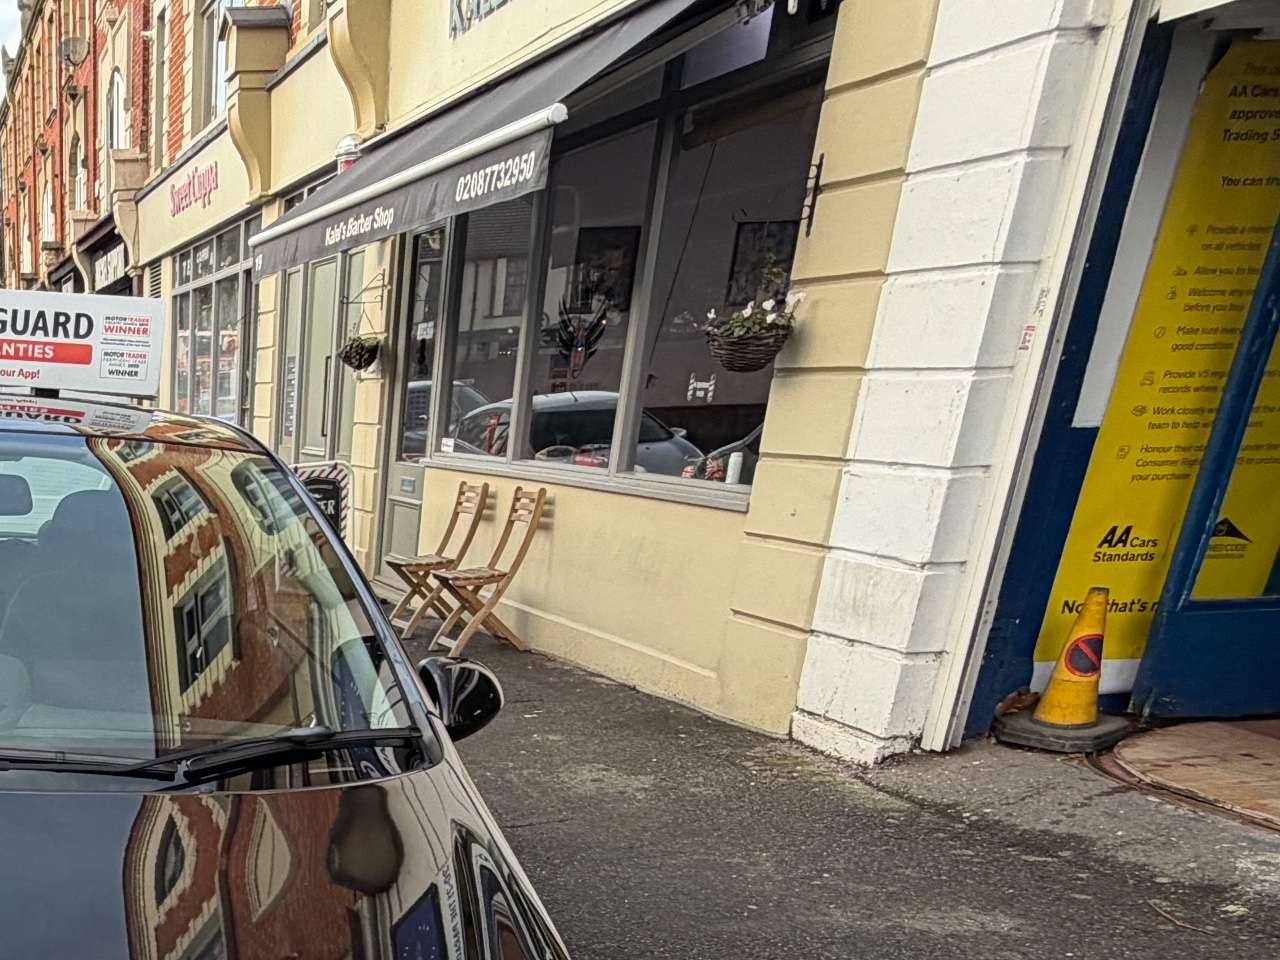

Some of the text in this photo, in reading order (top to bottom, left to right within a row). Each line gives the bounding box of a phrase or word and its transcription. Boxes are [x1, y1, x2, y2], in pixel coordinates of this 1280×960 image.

[1222, 128, 1269, 143] Trading
[455, 150, 536, 202] 02087732950
[1221, 176, 1241, 187] You
[1242, 177, 1264, 187] can
[170, 160, 218, 217] Sweet Cuppa
[347, 213, 373, 237] Barber
[373, 206, 394, 231] Shop
[104, 325, 149, 336] WINNER
[0, 368, 16, 378] our
[17, 368, 40, 381] App!
[108, 368, 139, 378] WINNER
[1158, 385, 1191, 394] records
[1152, 405, 1176, 415] Work
[1140, 444, 1176, 453] Honour
[1136, 458, 1179, 467] Consumer
[1131, 474, 1150, 484] your
[1097, 525, 1159, 548] AA Cars
[1092, 551, 1155, 562] Standards
[1107, 598, 1148, 613] hat's
